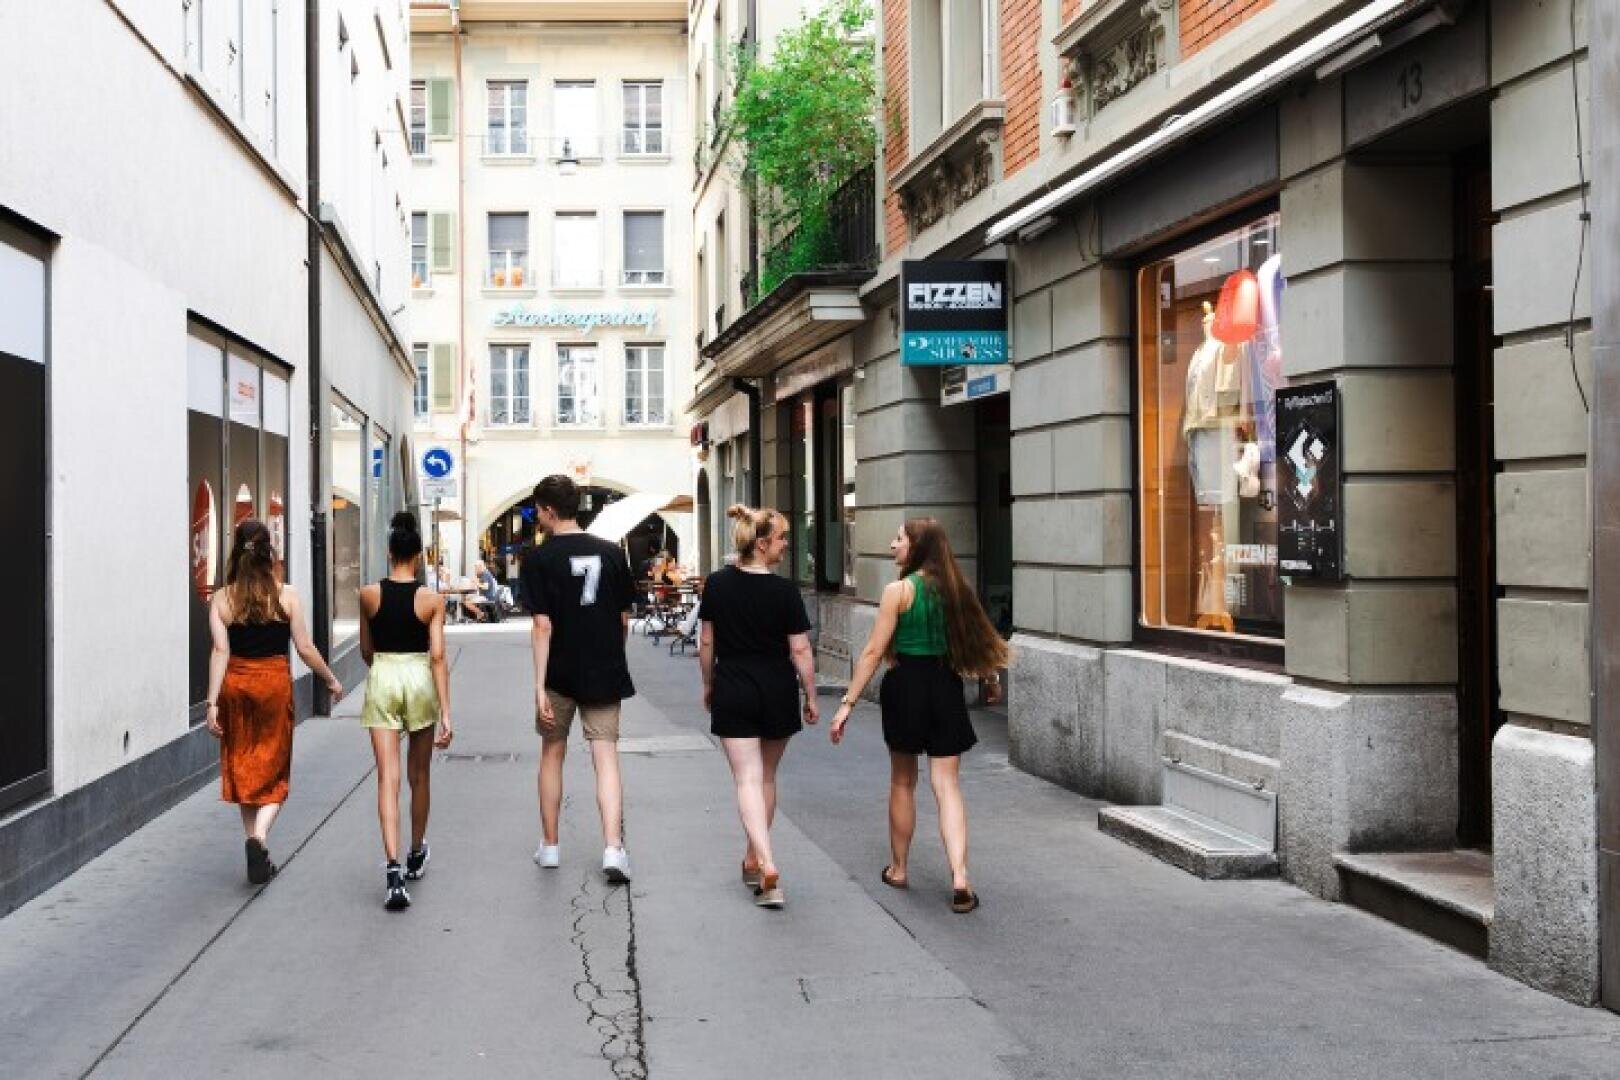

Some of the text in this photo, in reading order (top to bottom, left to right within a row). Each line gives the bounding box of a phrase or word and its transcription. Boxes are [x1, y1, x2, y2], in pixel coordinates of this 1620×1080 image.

[1397, 62, 1423, 109] 13
[908, 282, 1002, 303] FIZZEN
[569, 555, 603, 606] 7
